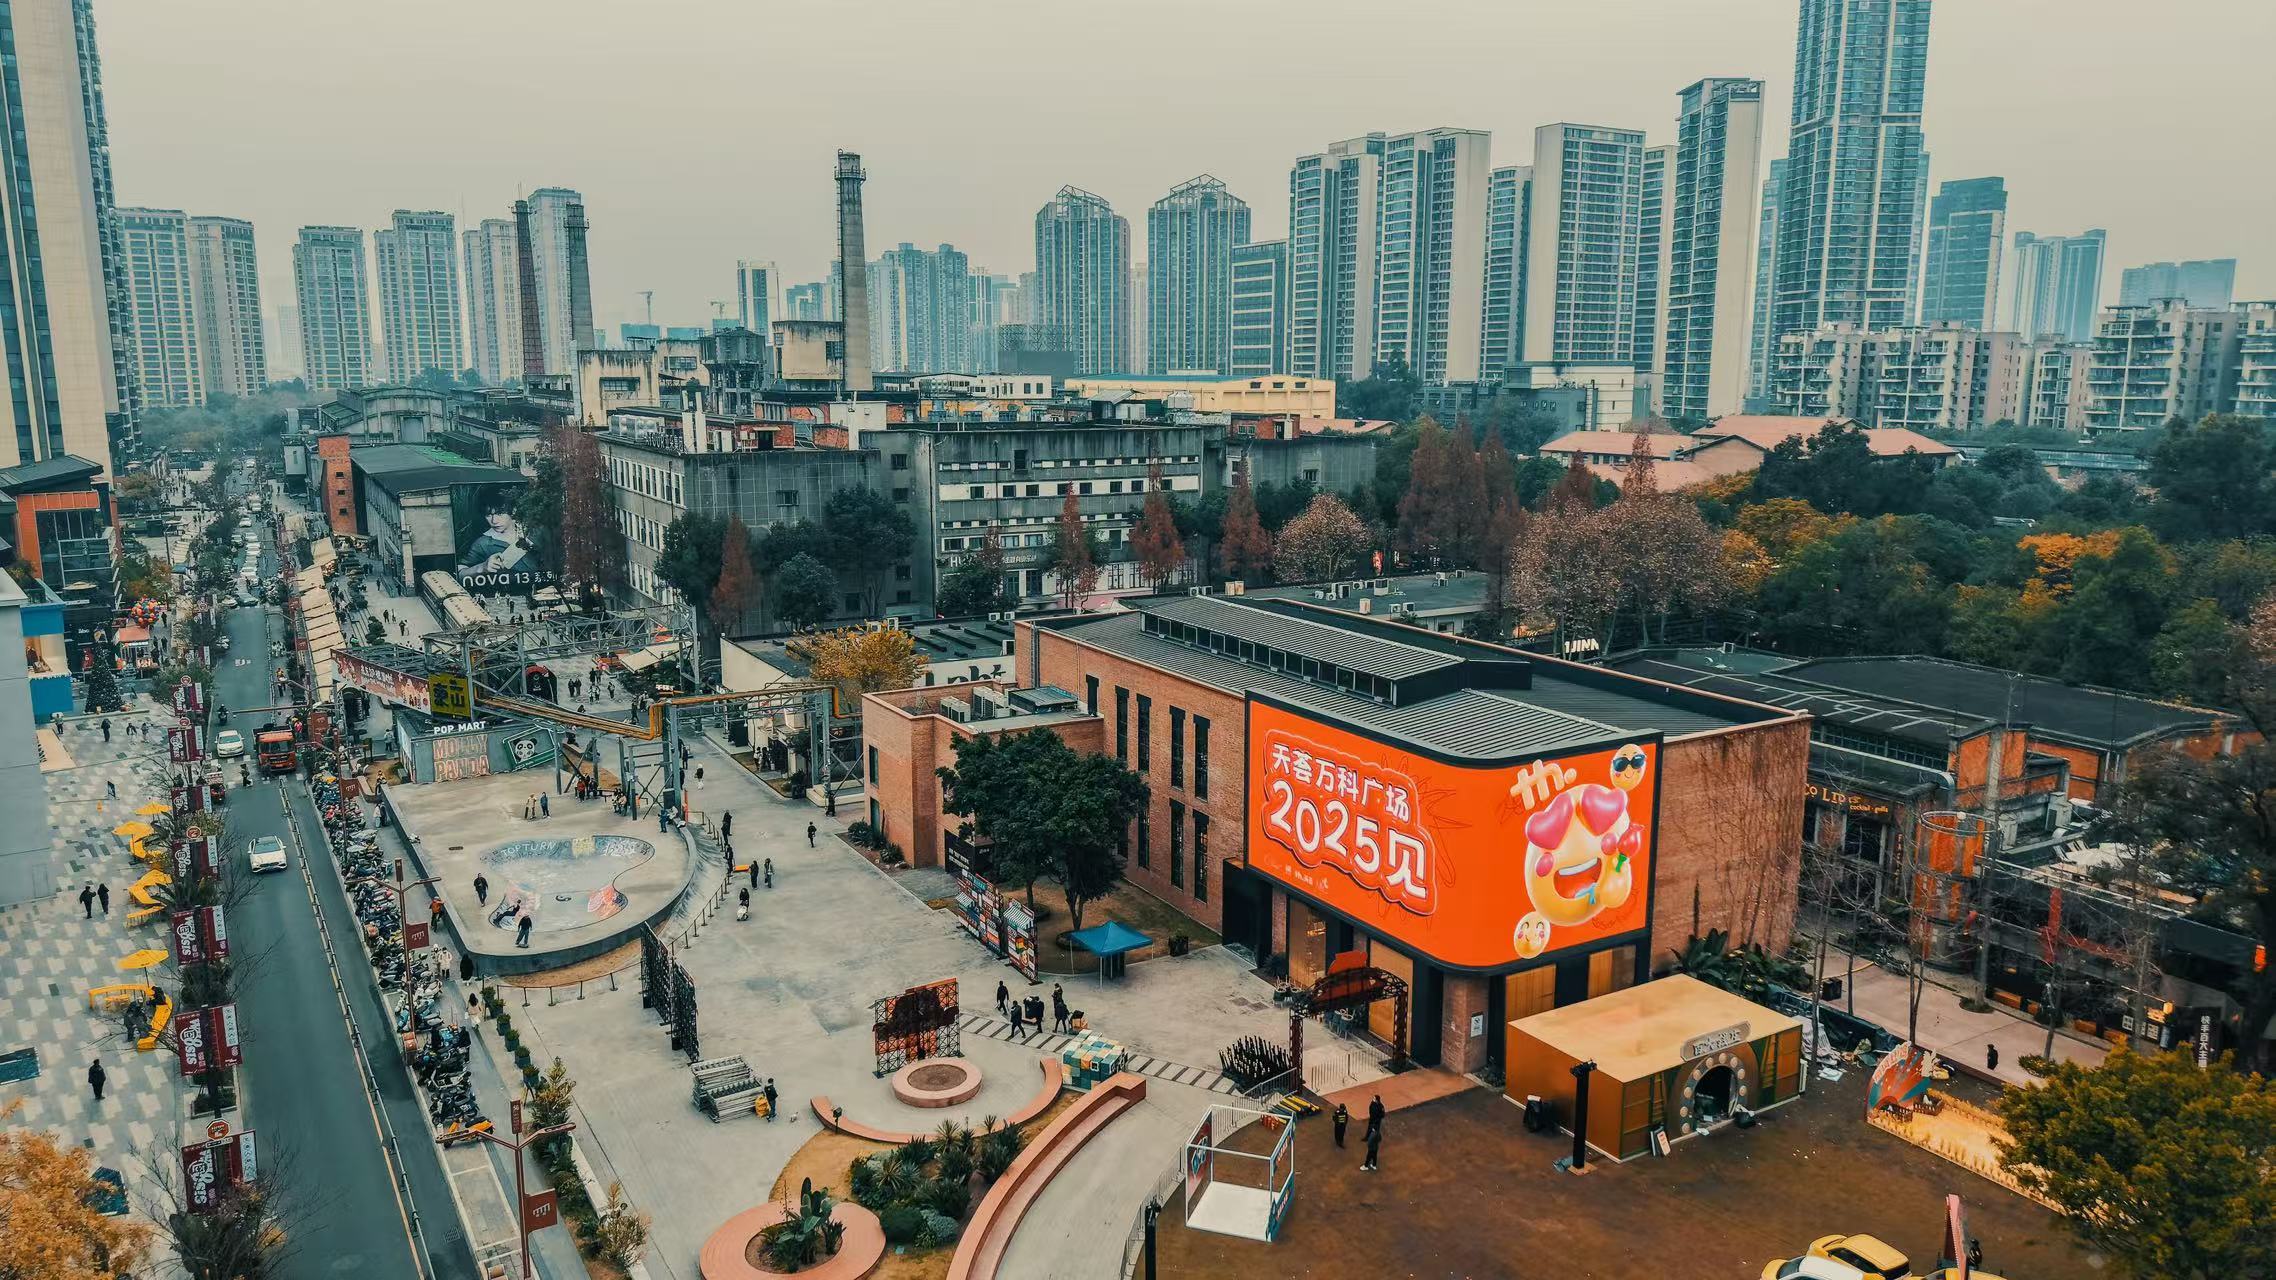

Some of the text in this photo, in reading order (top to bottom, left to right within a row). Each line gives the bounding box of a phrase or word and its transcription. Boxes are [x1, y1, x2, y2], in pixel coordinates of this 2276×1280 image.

[462, 573, 510, 587] nova
[514, 572, 530, 584] 13
[433, 721, 486, 735] POP MART
[433, 755, 490, 782] PANDA
[1271, 743, 1410, 823] 天荟万科广场
